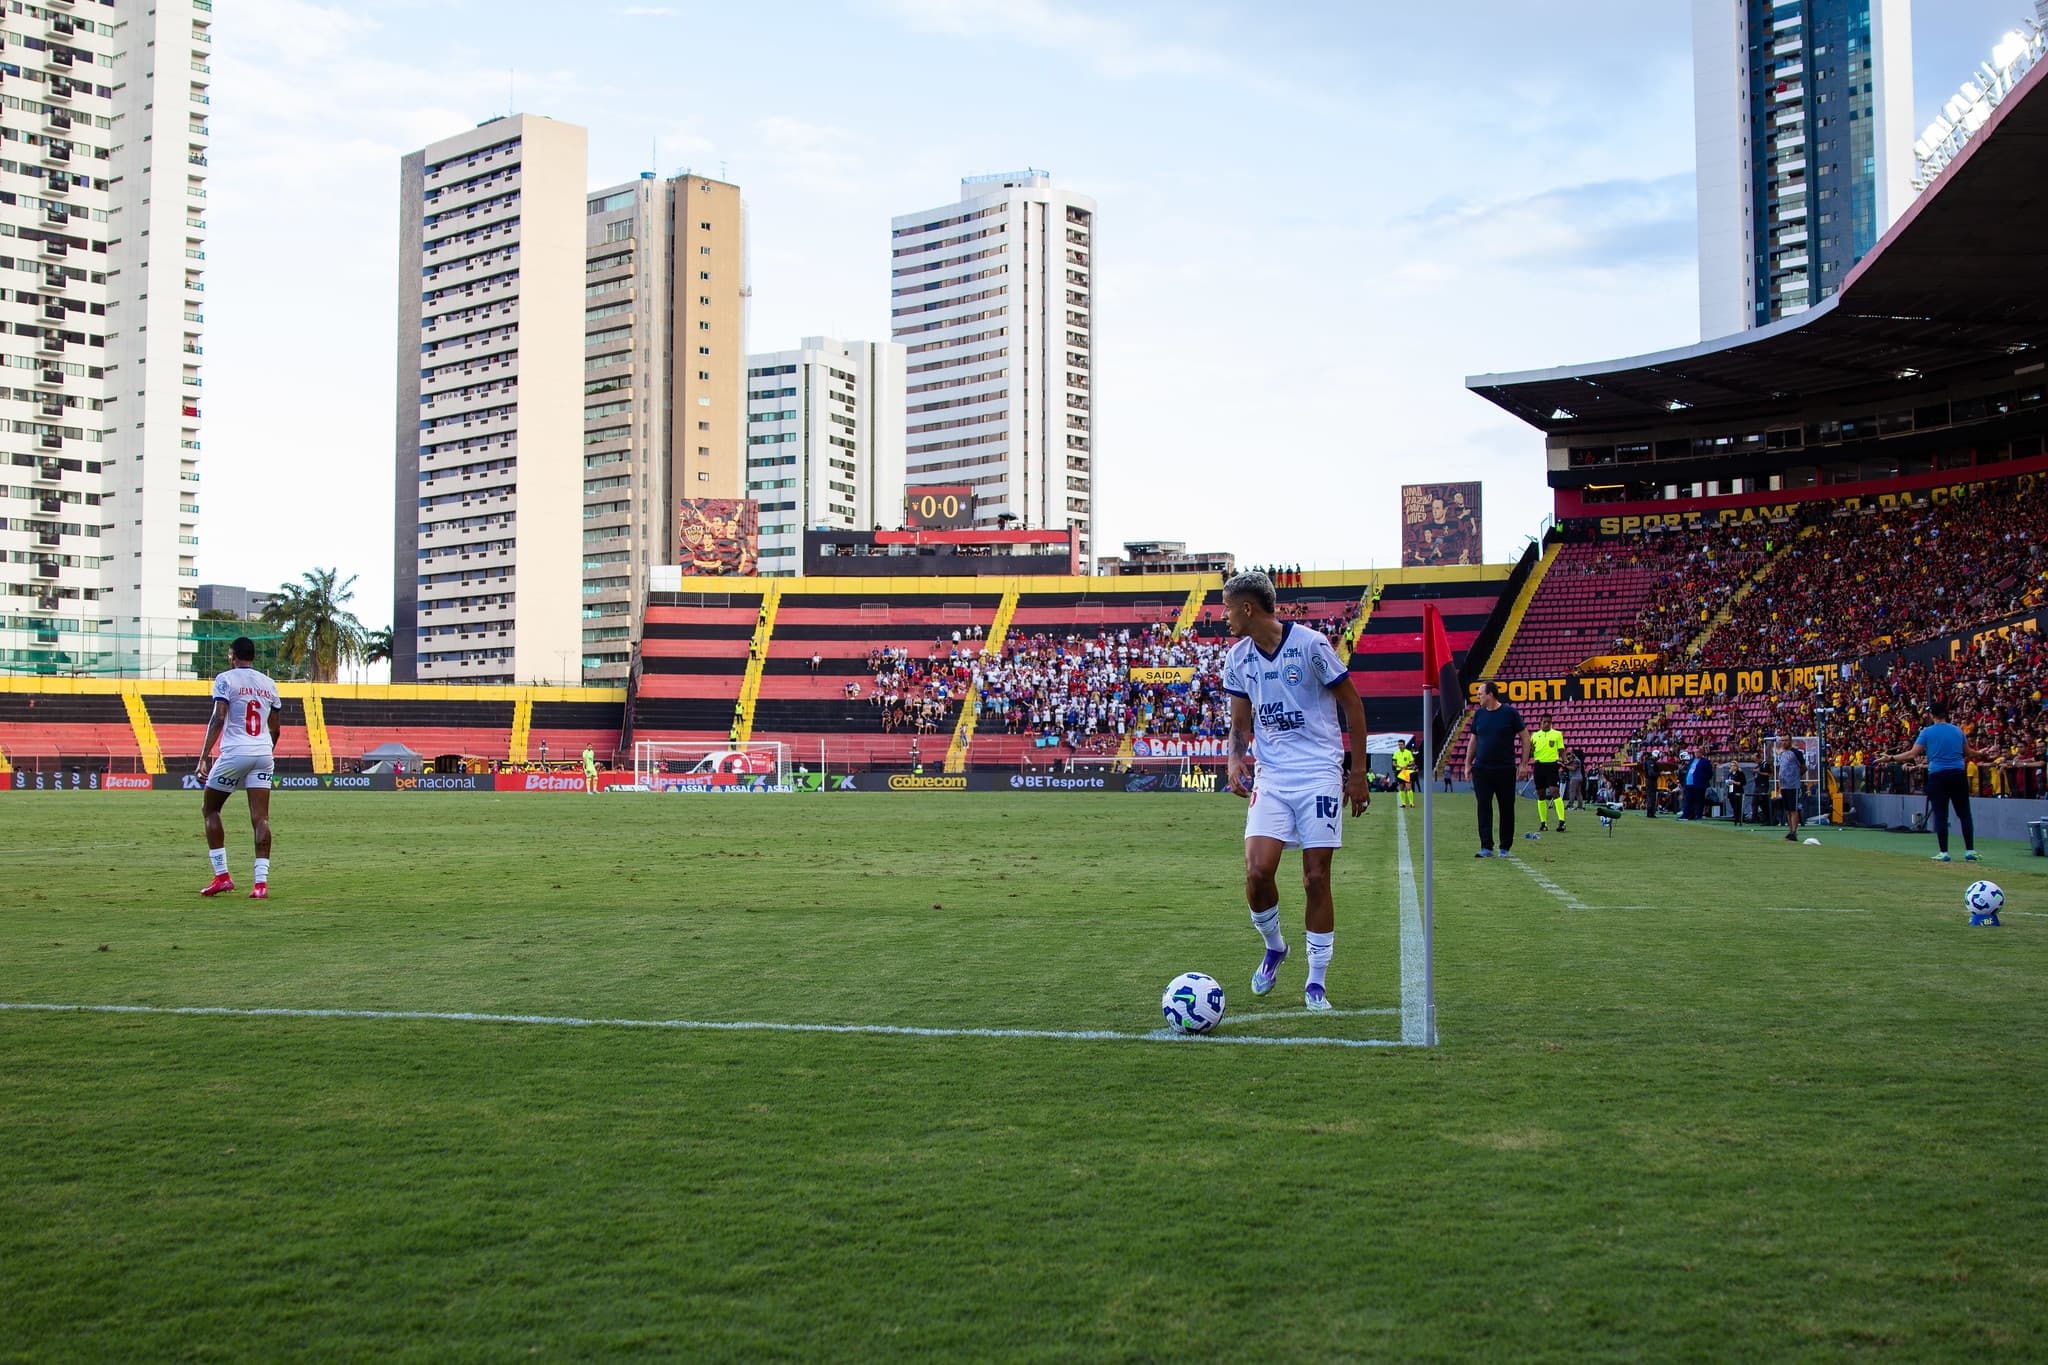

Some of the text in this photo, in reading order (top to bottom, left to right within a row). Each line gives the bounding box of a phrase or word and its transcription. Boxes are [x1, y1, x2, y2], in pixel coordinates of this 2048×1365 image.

[1403, 487, 1422, 496] UMA
[921, 495, 936, 518] 0
[943, 495, 958, 518] 0
[1600, 511, 1701, 535] SPORT
[1611, 656, 1648, 669] SAÍDA
[1146, 670, 1181, 679] SAÍDA
[239, 687, 253, 696] JEAN
[1469, 679, 1567, 703] SPORT
[1579, 671, 1727, 699] TRICAMPEÃO
[1737, 671, 1763, 694] DO
[1259, 702, 1283, 715] VIVA
[246, 700, 261, 736] 6
[1260, 711, 1304, 726] SORTE
[105, 776, 150, 788] Betano
[282, 777, 318, 787] SICOOB
[334, 777, 370, 787] SICOOB
[396, 776, 475, 789] betnacional
[526, 775, 584, 790] Betano
[831, 776, 857, 789] 7K
[891, 775, 967, 788] cobrecom
[1025, 776, 1104, 789] BETesporte
